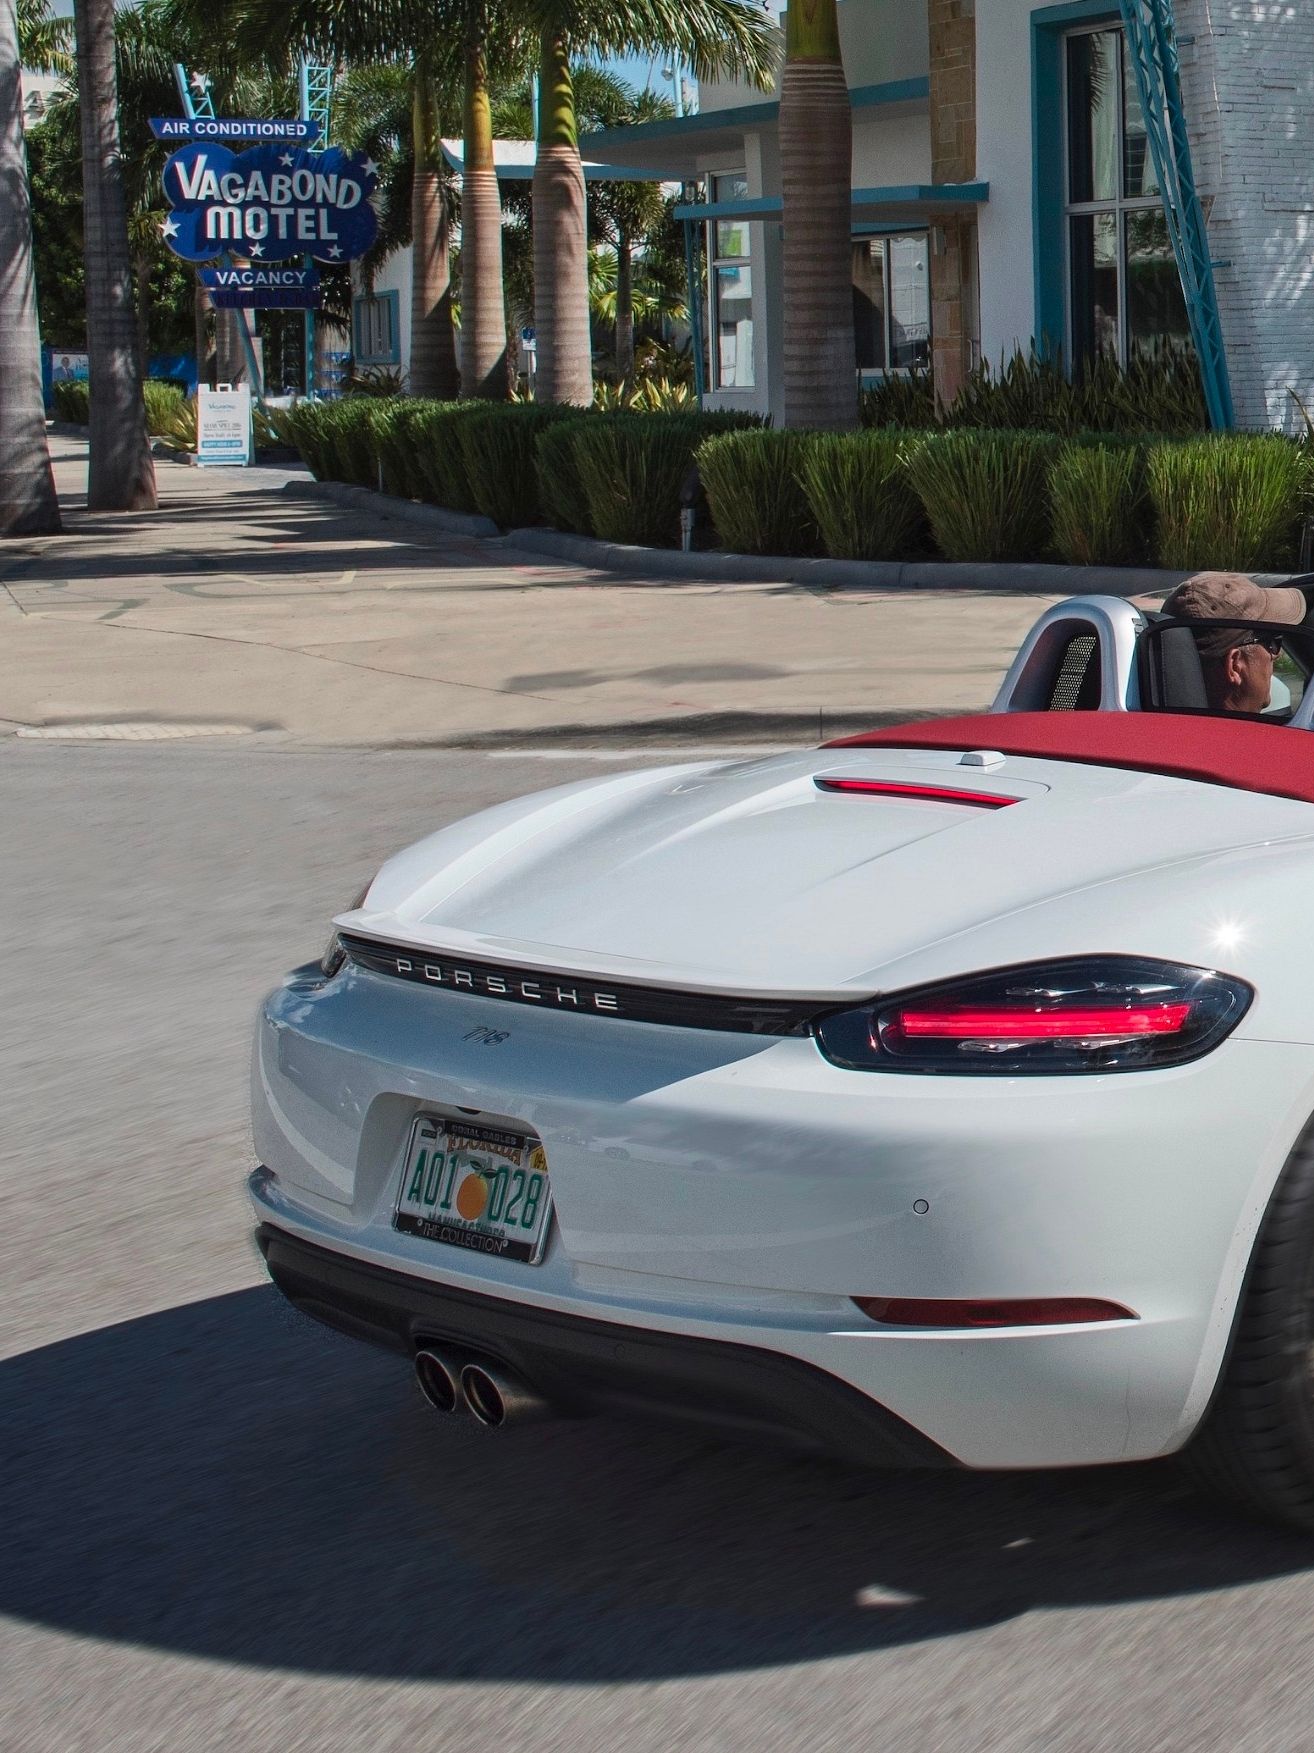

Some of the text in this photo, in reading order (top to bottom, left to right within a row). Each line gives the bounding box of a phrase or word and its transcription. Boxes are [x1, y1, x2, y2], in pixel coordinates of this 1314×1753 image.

[162, 122, 307, 136] AIR CONDITIONED
[174, 154, 361, 209] VAGABOND
[206, 206, 338, 240] MOTEL
[216, 271, 307, 285] VACANCY
[396, 958, 618, 1010] PORSCHE
[462, 1026, 510, 1046] 718
[439, 1227, 504, 1253] COLLECTION
